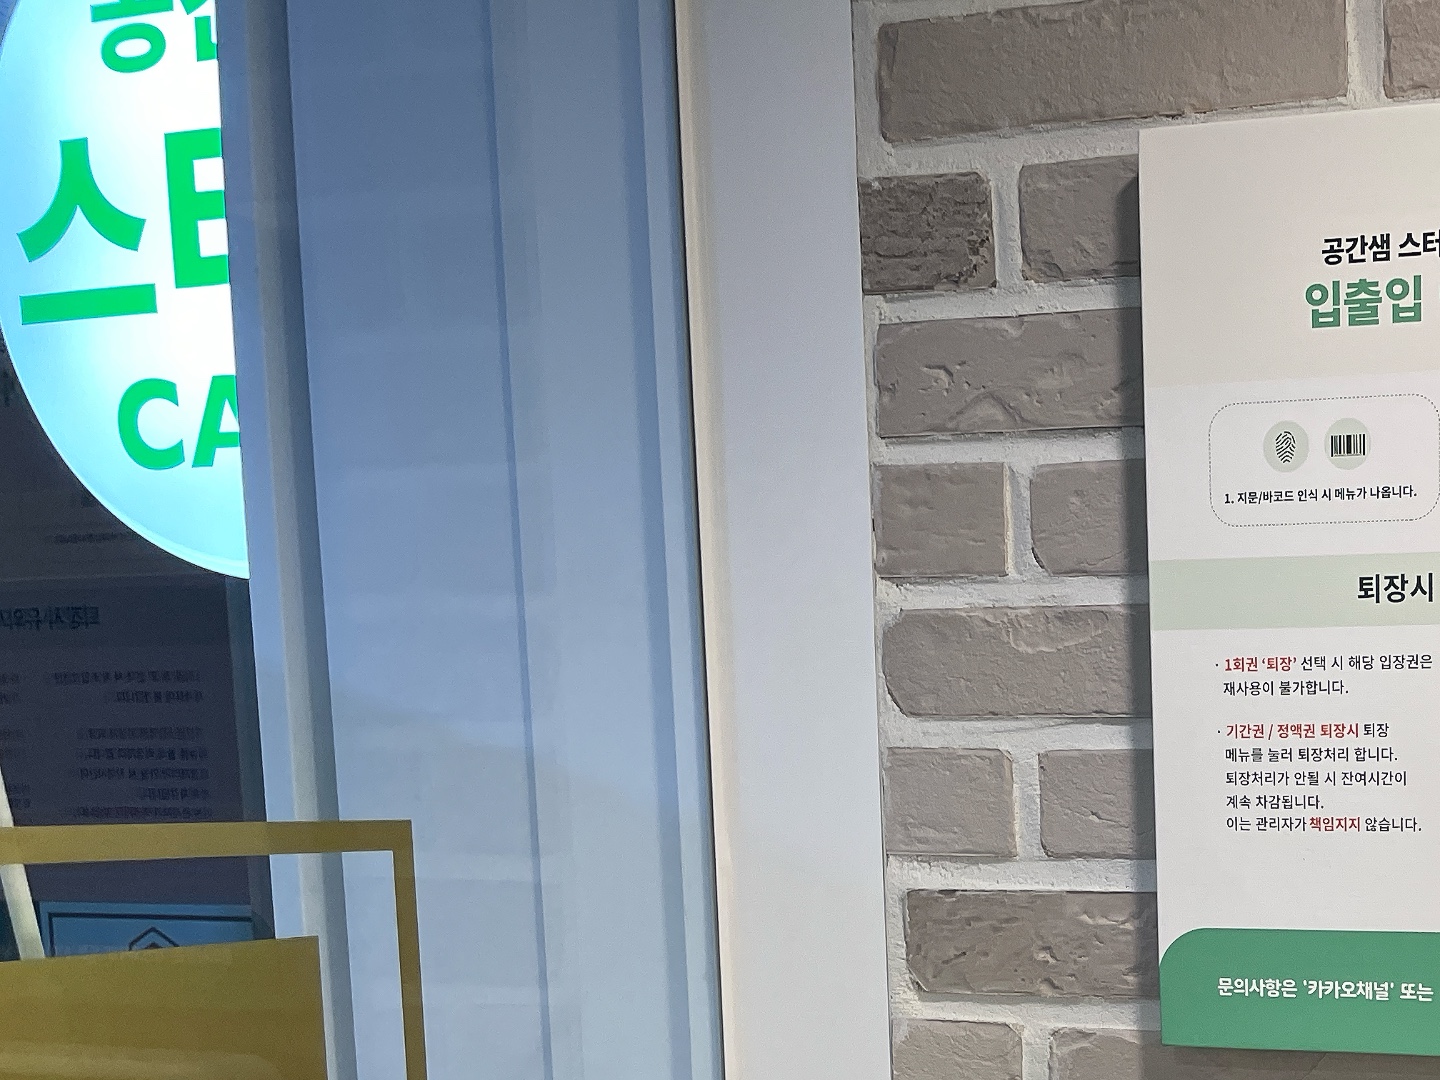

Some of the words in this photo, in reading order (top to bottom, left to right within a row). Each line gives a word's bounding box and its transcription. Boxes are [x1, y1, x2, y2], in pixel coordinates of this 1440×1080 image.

[1322, 233, 1390, 265] 공간샘
[1306, 275, 1421, 328] 입출입
[1225, 494, 1234, 504] 1.
[1238, 491, 1294, 504] 지문/바코드
[1298, 489, 1317, 501] 인식
[1322, 488, 1331, 501] 시
[1335, 487, 1367, 500] 메뉴가
[1371, 485, 1416, 499] 나옵니다.
[1358, 573, 1433, 603] 퇴장시
[1226, 657, 1258, 672] 1회권
[1301, 656, 1325, 671] 선택
[1331, 656, 1342, 670] 시
[1349, 655, 1374, 670] 해당
[1380, 654, 1432, 669] 입장권은
[1224, 681, 1273, 696] 재사용이
[1279, 680, 1348, 695] 불가합니다.
[1227, 724, 1264, 739] 기간권
[1278, 724, 1315, 738] 정액권
[1321, 723, 1358, 738] 퇴장시
[1364, 723, 1389, 737] 퇴장
[1226, 748, 1263, 762] 메뉴를
[1268, 748, 1292, 762] 눌러
[1298, 747, 1348, 762] 퇴장처리
[1354, 747, 1397, 761] 합니다.
[1226, 771, 1289, 786] 퇴장처리가
[1294, 771, 1318, 786] 안될
[1325, 771, 1335, 786] 시
[1342, 771, 1406, 786] 잔여시간이
[1227, 795, 1251, 809] 계속
[1256, 795, 1323, 809] 차감됩니다.
[1227, 817, 1251, 831] 이는
[1256, 817, 1307, 831] 관리자가
[1310, 817, 1360, 832] 책임지지
[1365, 817, 1421, 832] 않습니다.
[1218, 977, 1297, 998] 문의사항은
[1400, 983, 1433, 1002] 또는
